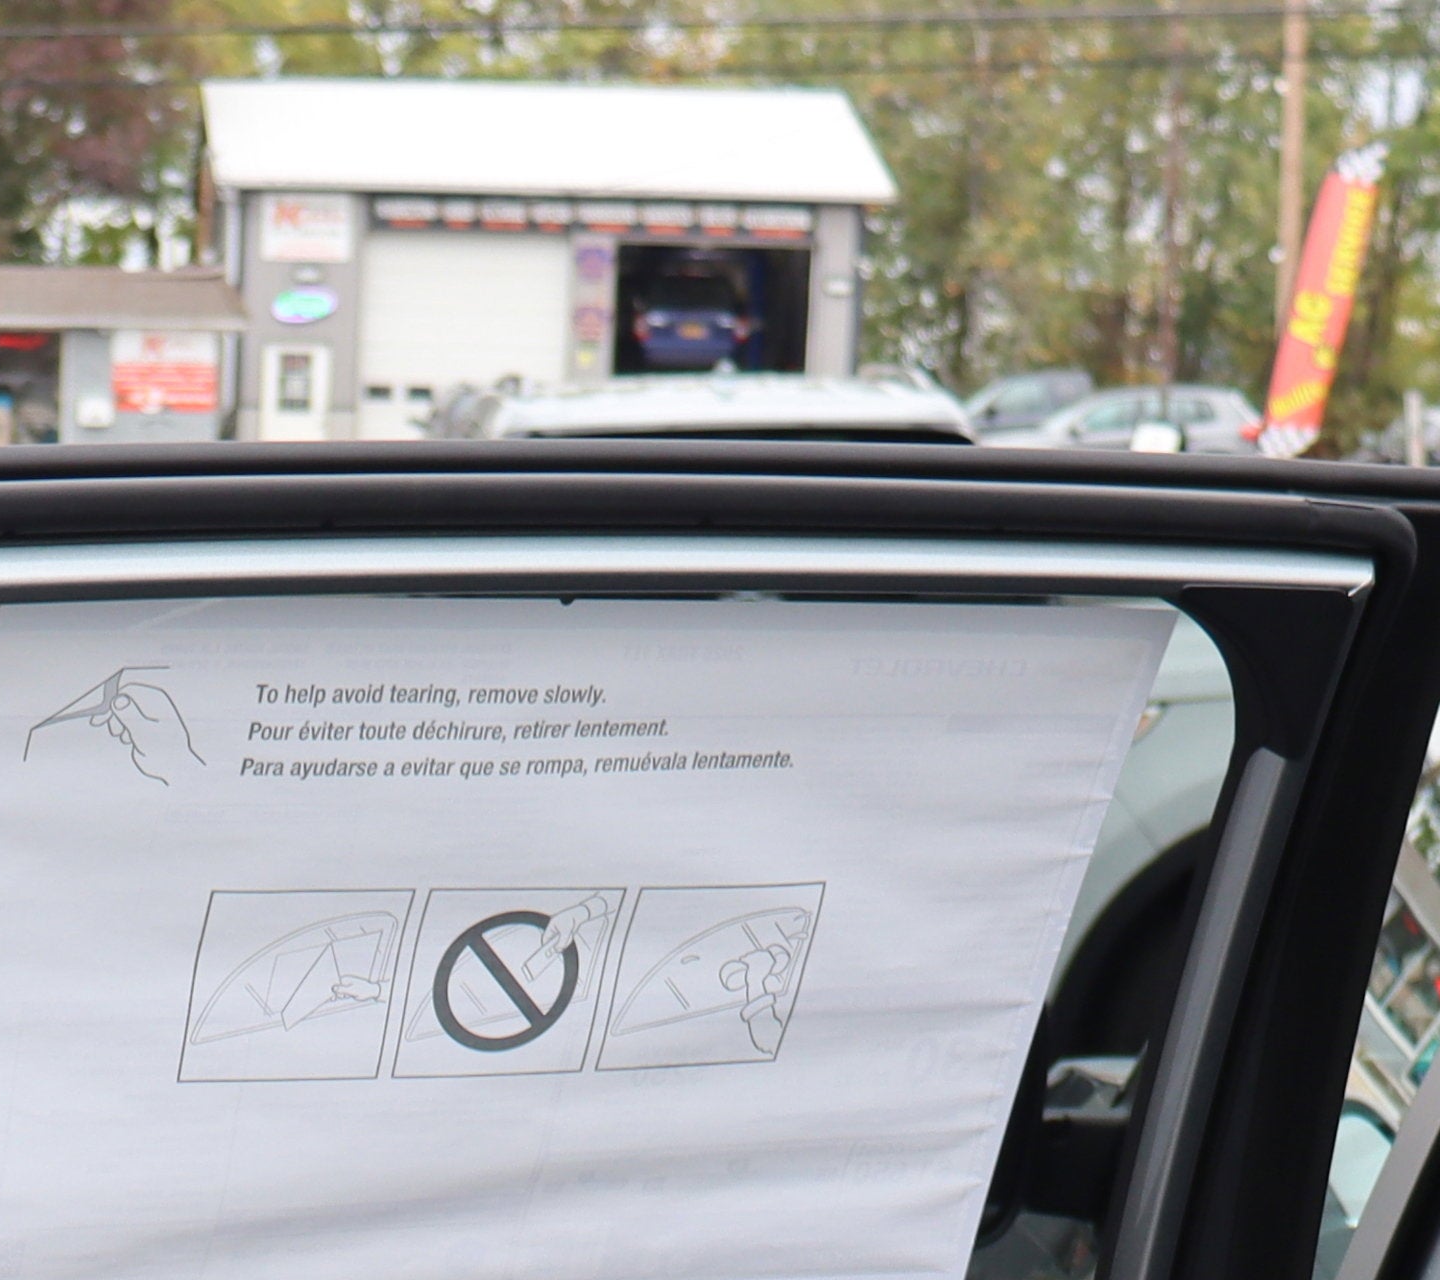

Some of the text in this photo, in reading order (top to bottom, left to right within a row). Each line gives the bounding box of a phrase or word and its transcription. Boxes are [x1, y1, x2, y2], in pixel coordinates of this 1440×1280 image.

[257, 684, 607, 708] To help avoid tearing, remove slowly.
[248, 719, 670, 743] Pour éviter toute déchirure, retirer lentement.
[240, 751, 795, 781] Para ayudarse a evitar que se rompa, remuévala lentamente.
